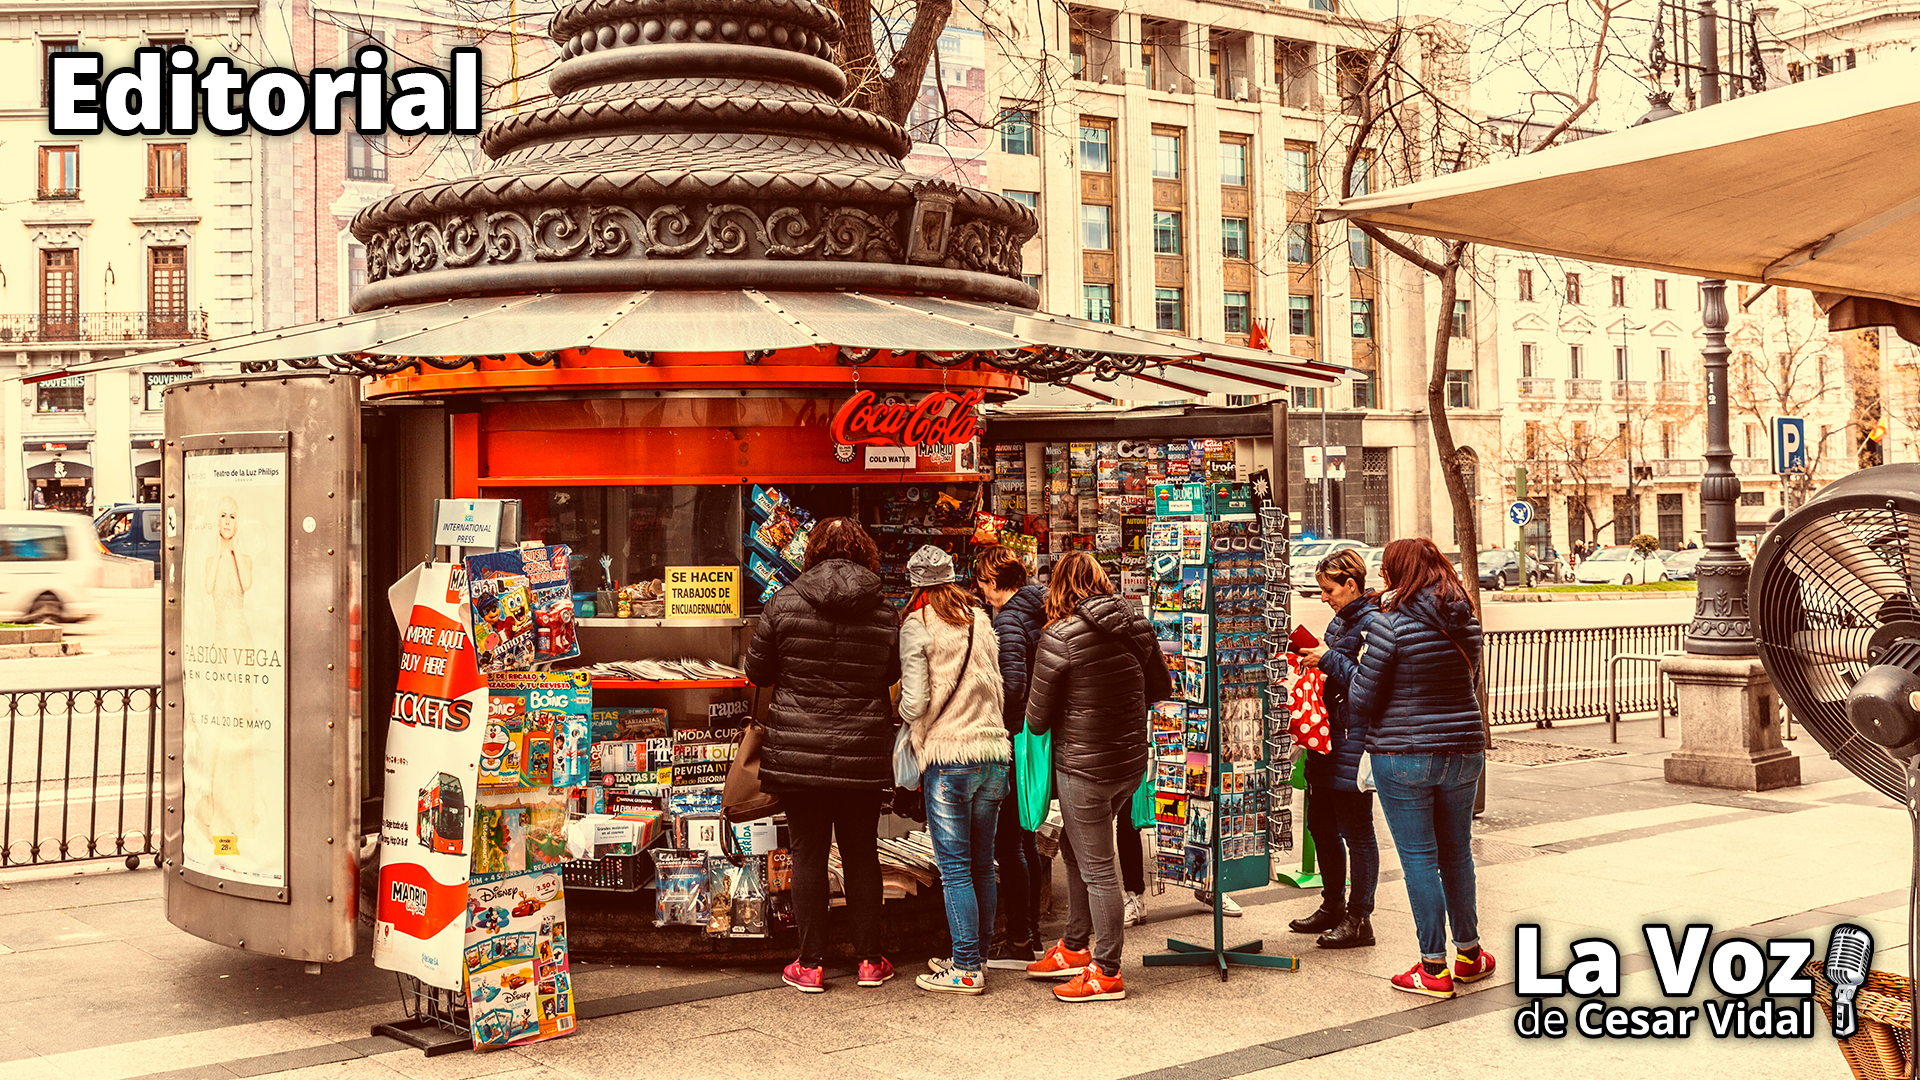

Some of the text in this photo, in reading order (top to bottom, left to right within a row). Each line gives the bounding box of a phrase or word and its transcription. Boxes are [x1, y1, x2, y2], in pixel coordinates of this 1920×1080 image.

[830, 388, 987, 447] Coca-Cola
[1782, 423, 1800, 468] P
[213, 469, 231, 478] Teatro
[230, 469, 239, 477] de
[239, 468, 246, 477] la
[246, 469, 257, 477] Luz
[257, 468, 280, 477] Philips
[442, 523, 492, 533] INTERNATIONAL
[456, 535, 476, 544] PRESS
[671, 571, 733, 583] SE HACEN
[671, 587, 731, 599] TRABAJOS DE
[232, 648, 282, 668] VEGA
[400, 652, 448, 677] BUY HERE
[189, 669, 270, 685] EN CONCIERTO
[508, 673, 538, 681] REGALO
[539, 682, 572, 690] REVISTA
[709, 700, 749, 718] Tapas
[201, 714, 209, 725] 15
[210, 715, 221, 726] AL
[222, 716, 232, 727] 20
[233, 717, 244, 729] DE
[246, 719, 272, 731] MAYO
[677, 729, 712, 741] MODA
[674, 764, 714, 776] REVISTA
[614, 772, 648, 783] TARTAS
[482, 789, 494, 797] LOS
[536, 882, 552, 892] 3.50
[391, 880, 428, 908] MADRID
